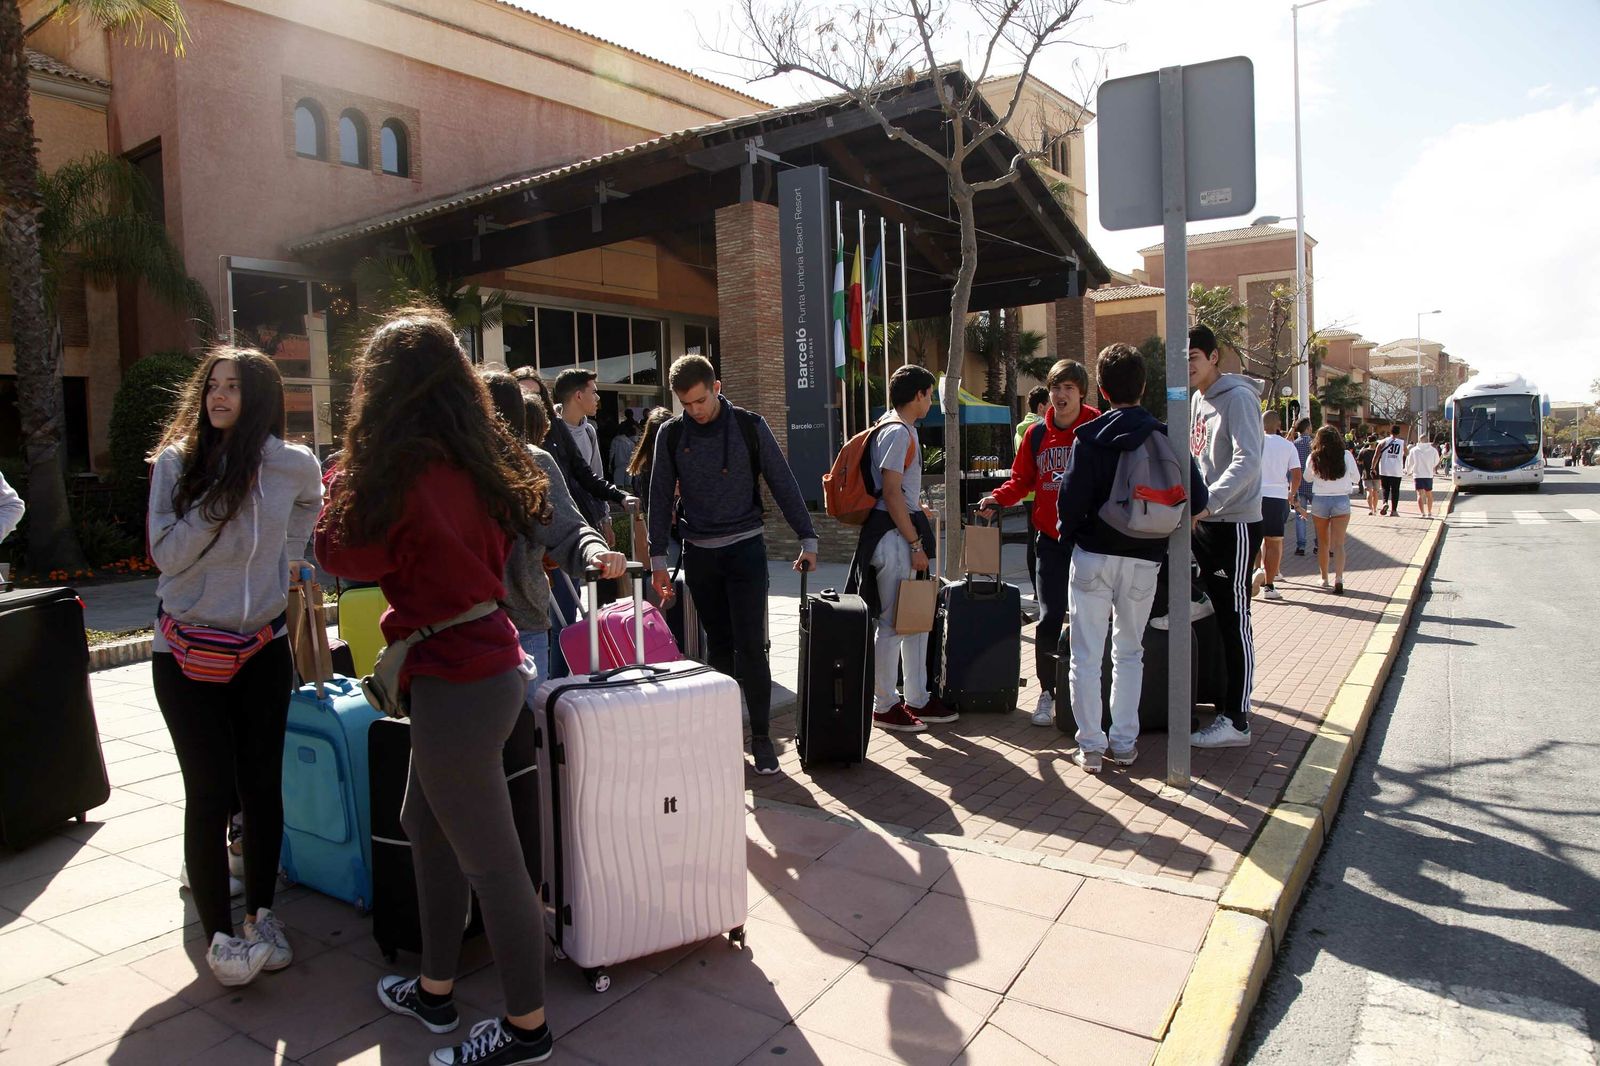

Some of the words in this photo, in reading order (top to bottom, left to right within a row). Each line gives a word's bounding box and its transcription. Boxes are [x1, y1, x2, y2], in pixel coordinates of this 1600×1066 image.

[795, 188, 803, 220] Resort
[796, 223, 804, 254] Beach
[797, 255, 806, 293] Umbria
[798, 294, 807, 324] Punta
[796, 327, 809, 389] Barceló
[1388, 443, 1401, 455] 30
[663, 795, 678, 814] it
